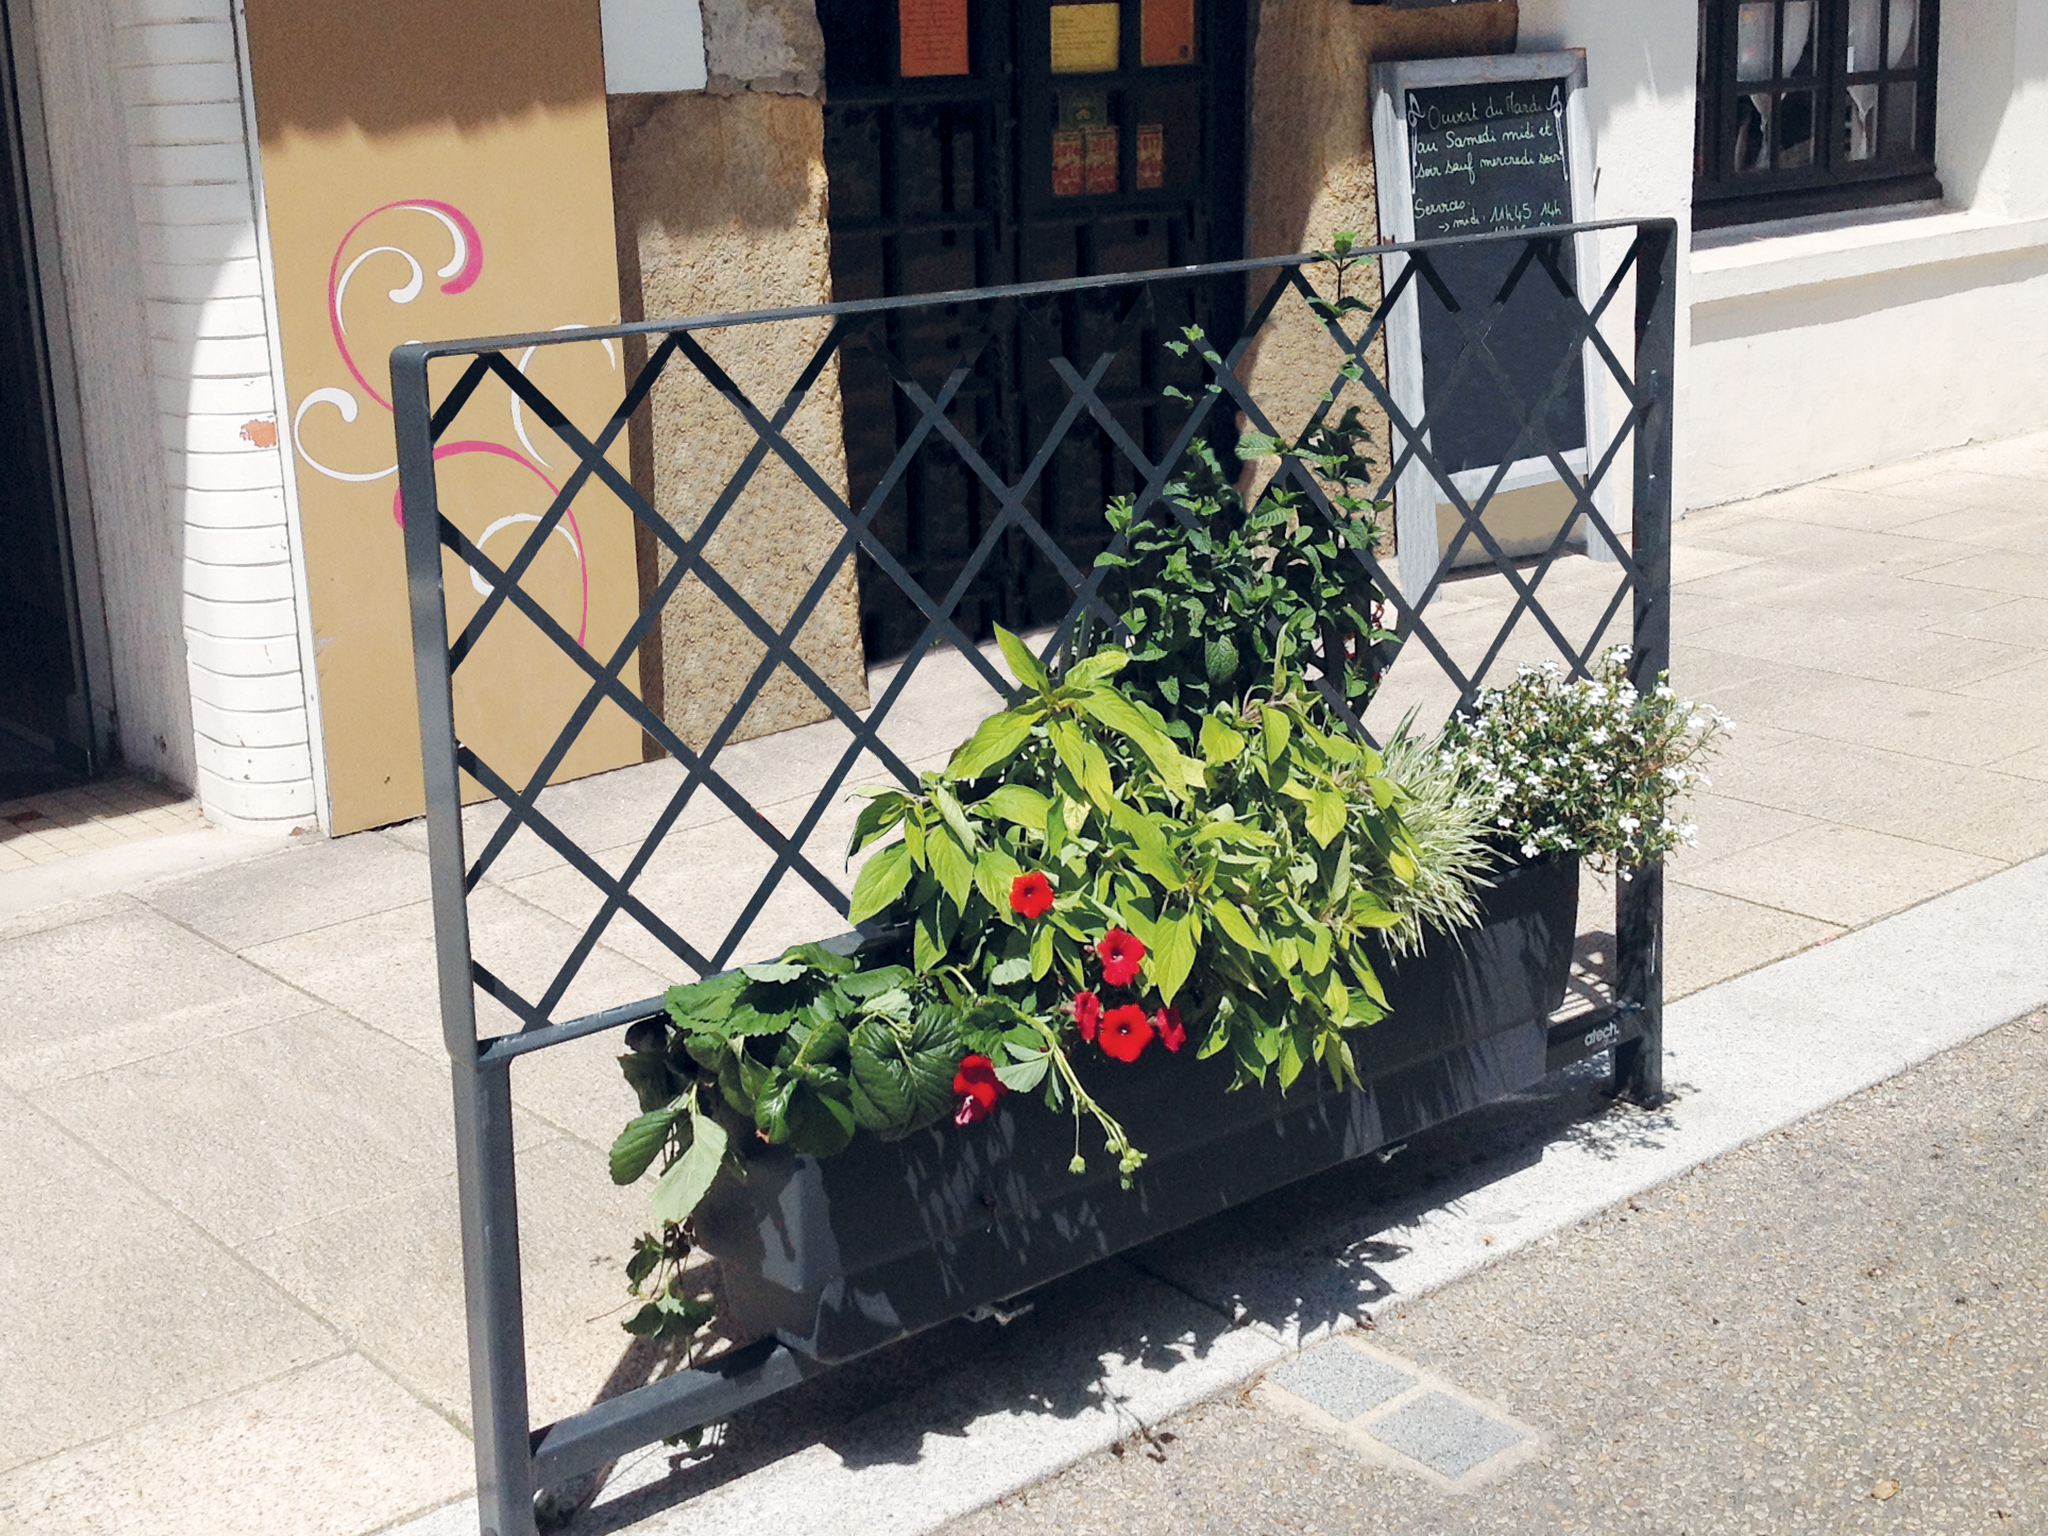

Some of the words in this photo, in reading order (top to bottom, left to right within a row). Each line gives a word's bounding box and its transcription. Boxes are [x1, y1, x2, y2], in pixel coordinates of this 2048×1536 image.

[1428, 102, 1479, 130] Ouvert
[1486, 97, 1503, 117] du
[1506, 92, 1542, 113] Mardi
[1417, 141, 1439, 154] au
[1446, 125, 1497, 149] Samedi
[1501, 121, 1535, 141] midi
[1538, 119, 1553, 137] et
[1444, 152, 1475, 185] sauf
[1479, 148, 1535, 168] mercredi
